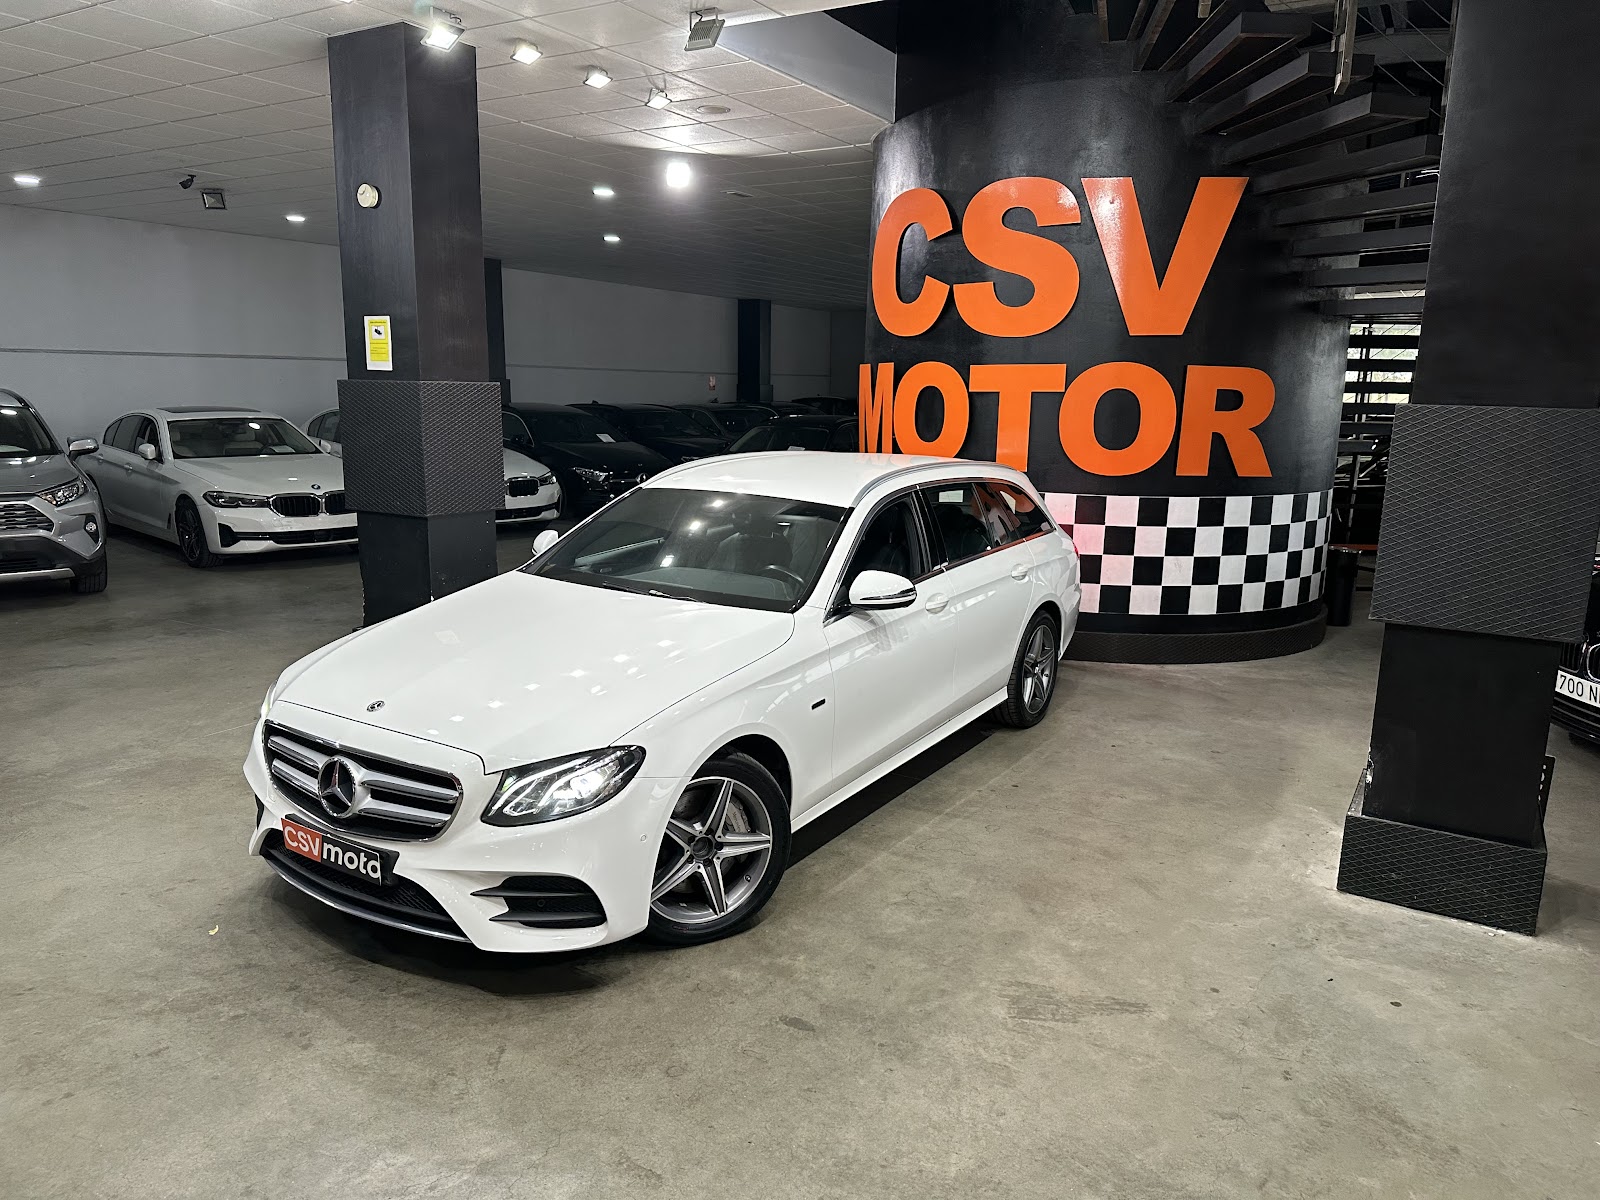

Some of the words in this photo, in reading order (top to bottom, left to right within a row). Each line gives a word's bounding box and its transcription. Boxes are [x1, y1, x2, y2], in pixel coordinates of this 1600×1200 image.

[872, 176, 1249, 338] CSV
[858, 361, 1276, 478] MOTOR
[1588, 684, 1600, 704] N
